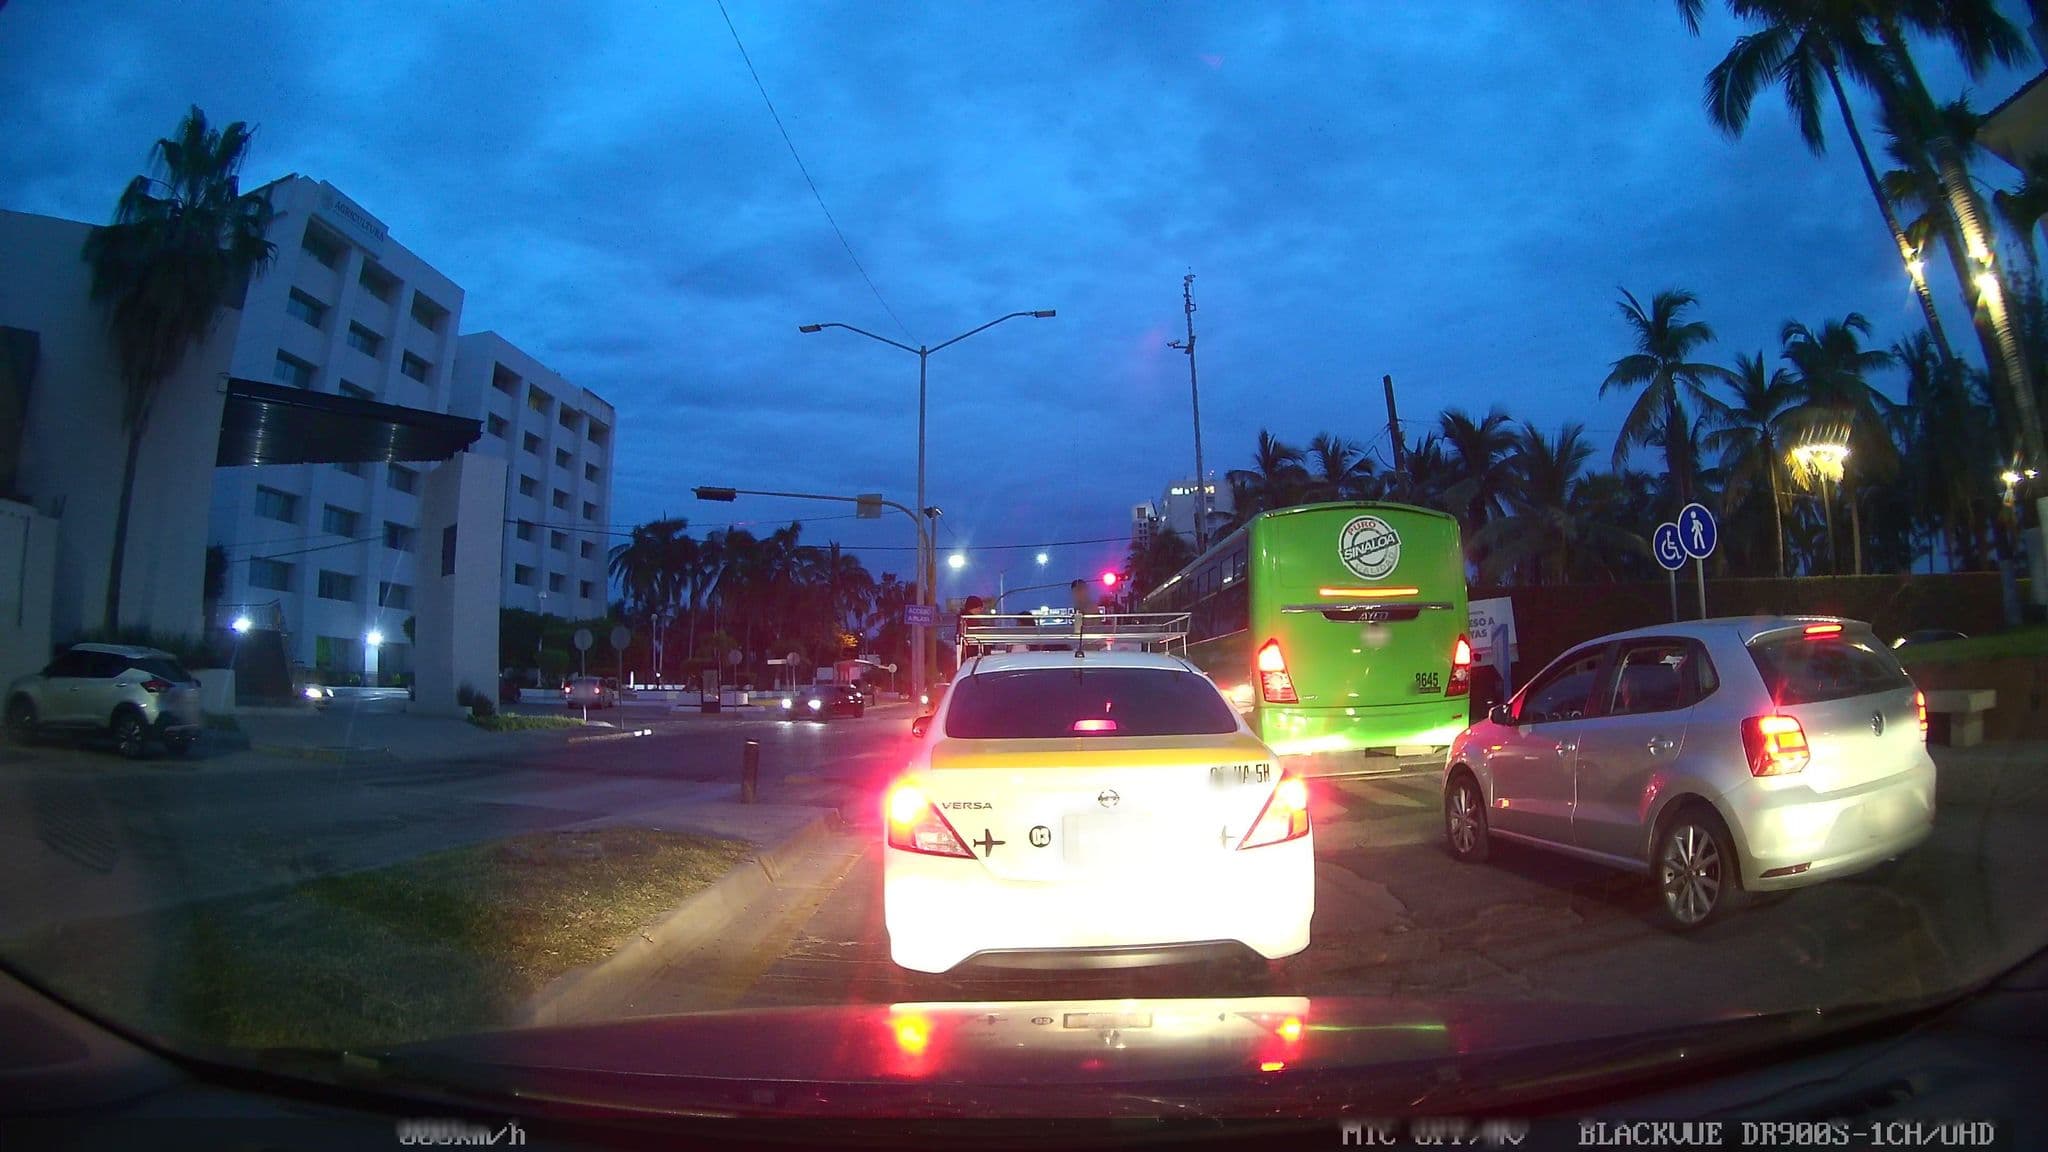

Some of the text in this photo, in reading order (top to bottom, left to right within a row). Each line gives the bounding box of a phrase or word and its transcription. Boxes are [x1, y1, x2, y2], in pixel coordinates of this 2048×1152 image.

[1348, 521, 1376, 536] PURO
[1344, 533, 1396, 560] SINALOA
[1488, 617, 1496, 626] A
[942, 802, 993, 810] VERSA
